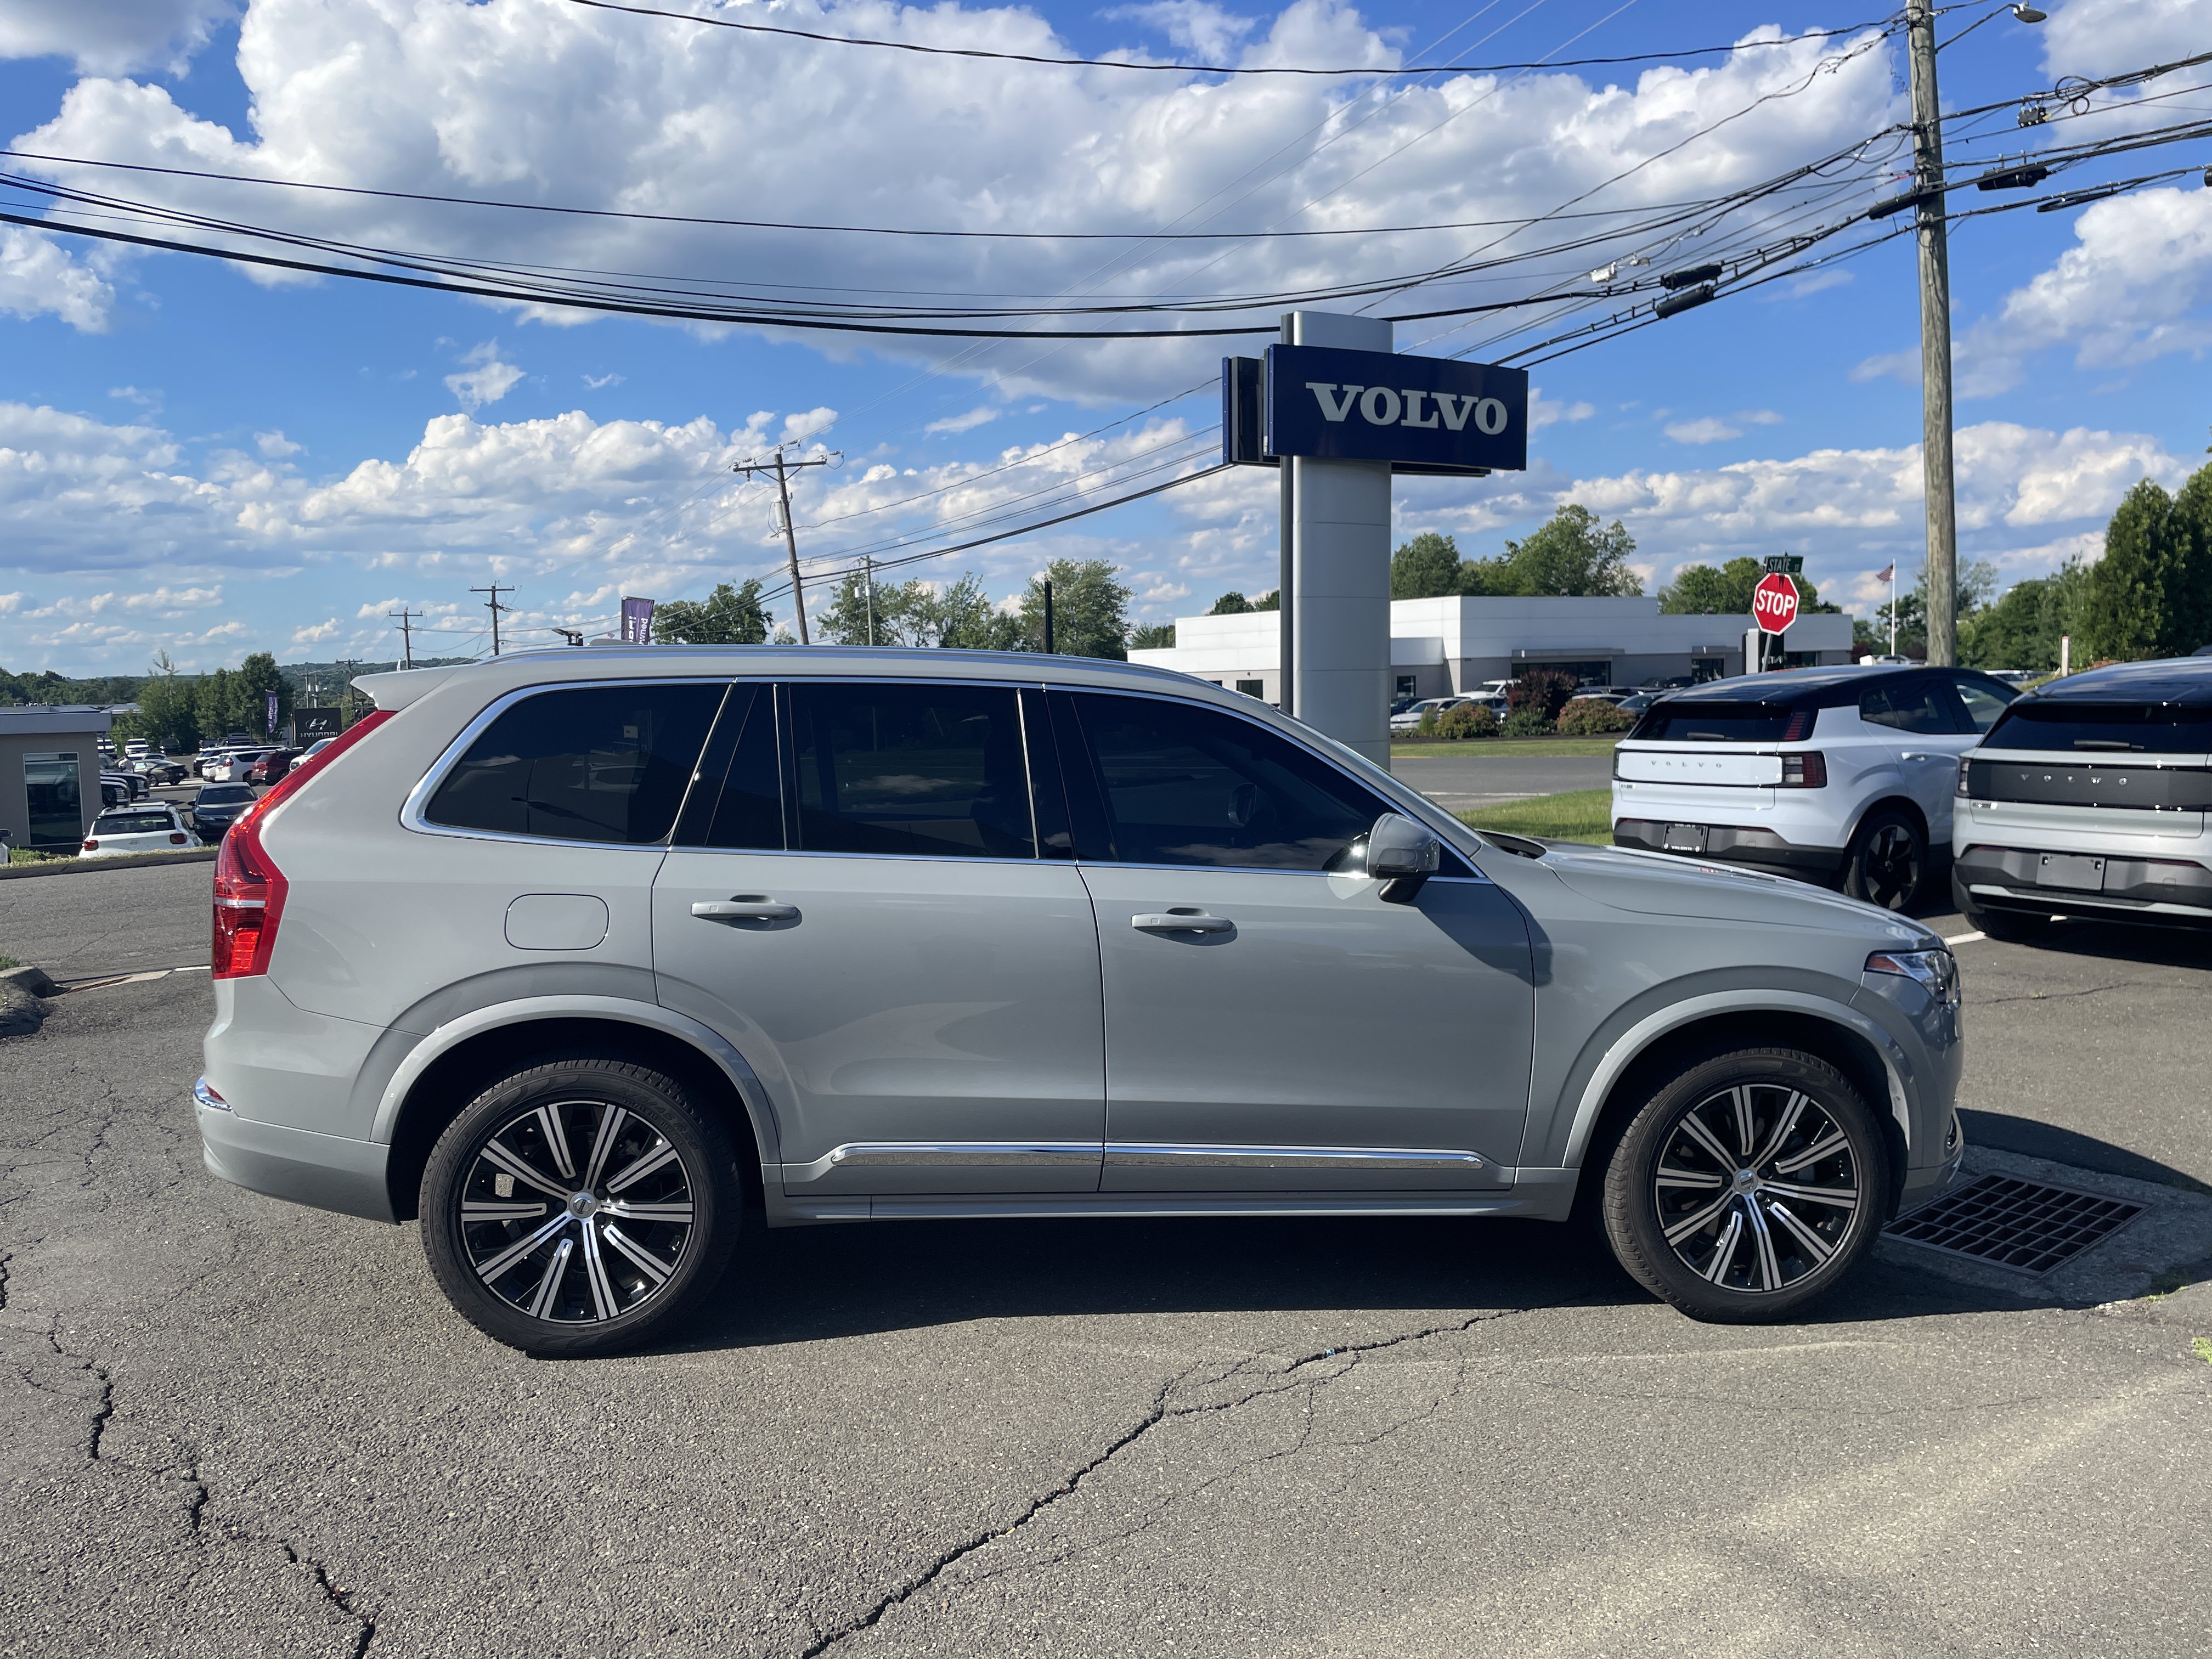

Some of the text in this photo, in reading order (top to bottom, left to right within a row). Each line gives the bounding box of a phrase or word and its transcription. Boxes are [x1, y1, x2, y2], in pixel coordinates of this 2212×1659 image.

[1306, 382, 1508, 435] VOLVO
[1768, 558, 1791, 572] STATE
[1757, 589, 1795, 617] STOP
[1651, 760, 1722, 768] VOLVO
